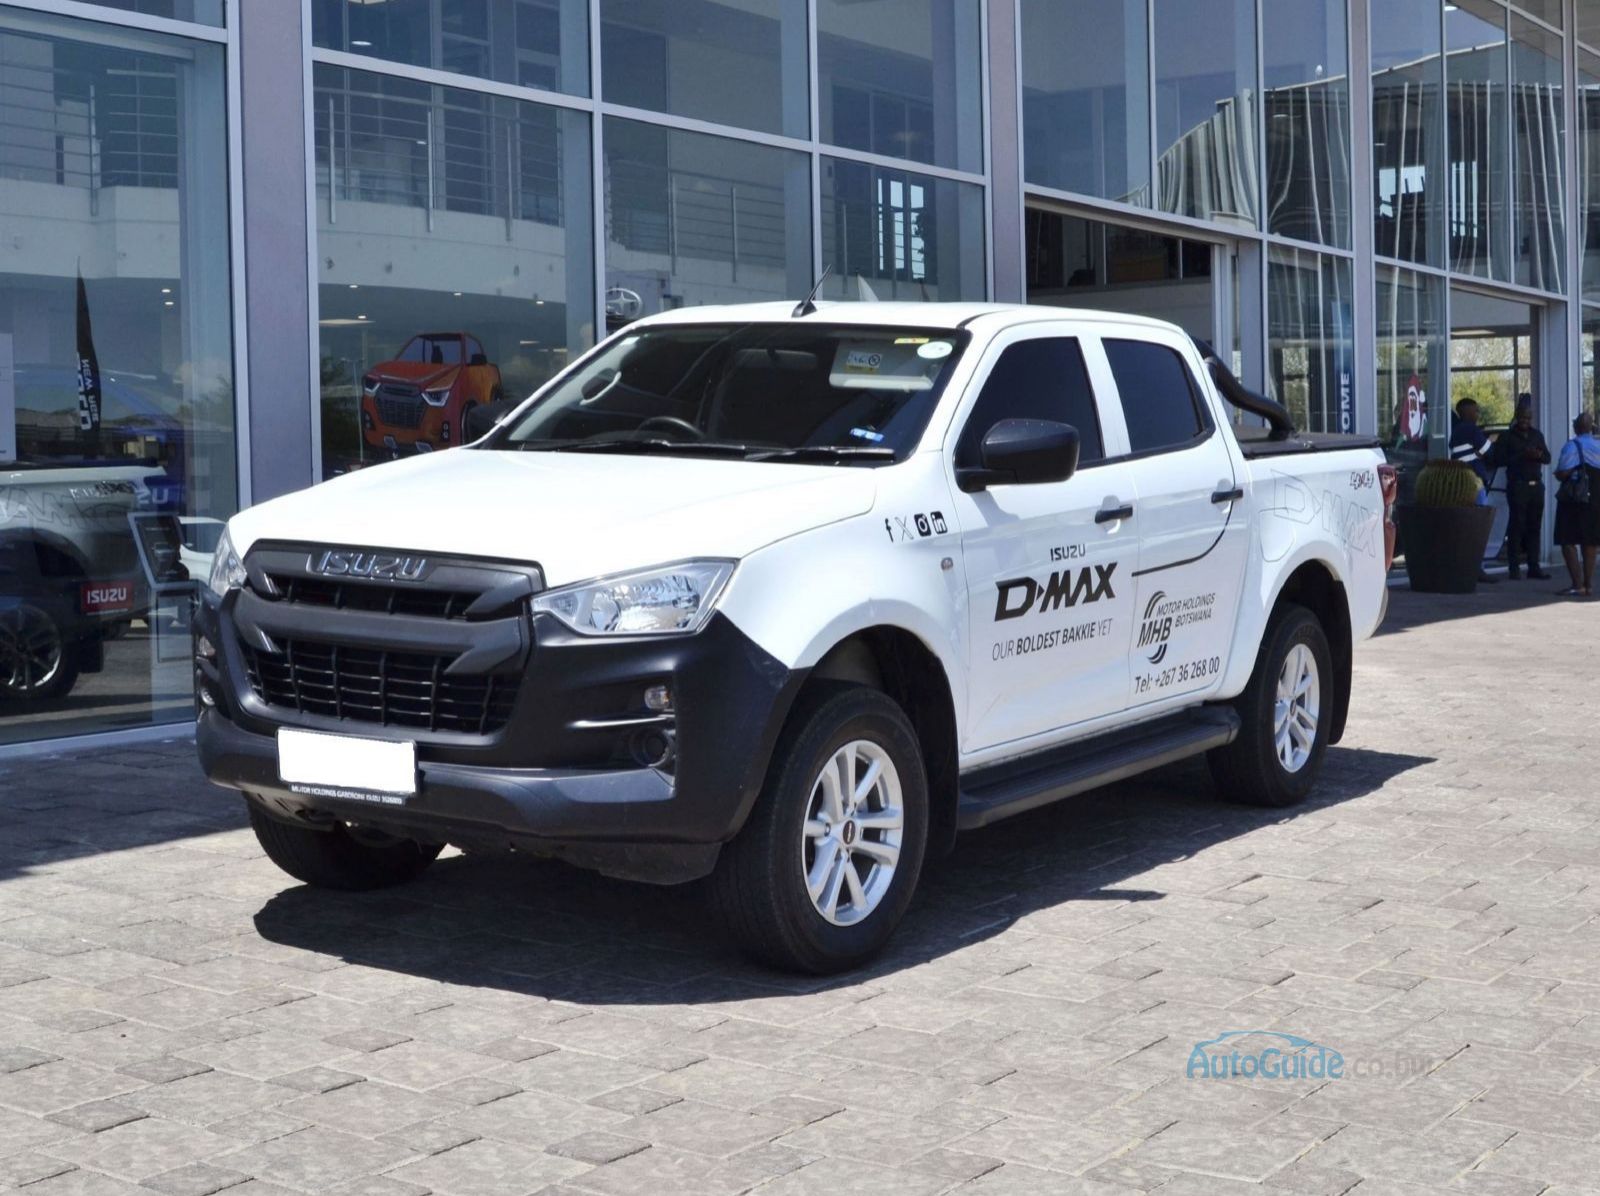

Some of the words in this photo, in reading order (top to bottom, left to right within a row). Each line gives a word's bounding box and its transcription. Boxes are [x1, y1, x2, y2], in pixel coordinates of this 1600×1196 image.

[1340, 372, 1350, 434] OME
[316, 550, 428, 580] ISUZU
[1050, 543, 1086, 561] ISUZU
[87, 586, 128, 605] ISUZU
[1156, 600, 1182, 617] MOTOR
[1183, 592, 1216, 612] HOLDINGS
[1137, 617, 1172, 648] MHB
[1175, 608, 1212, 628] BOTSWANA
[992, 639, 1014, 661] OUR
[1016, 630, 1061, 655] BOLDEST
[1062, 622, 1096, 645] BAKKIE
[1097, 618, 1113, 637] YET
[1135, 672, 1153, 695] Tel:
[1155, 667, 1177, 688] +267
[1178, 663, 1189, 683] 36
[1190, 658, 1207, 680] 268
[1208, 655, 1220, 675] 00
